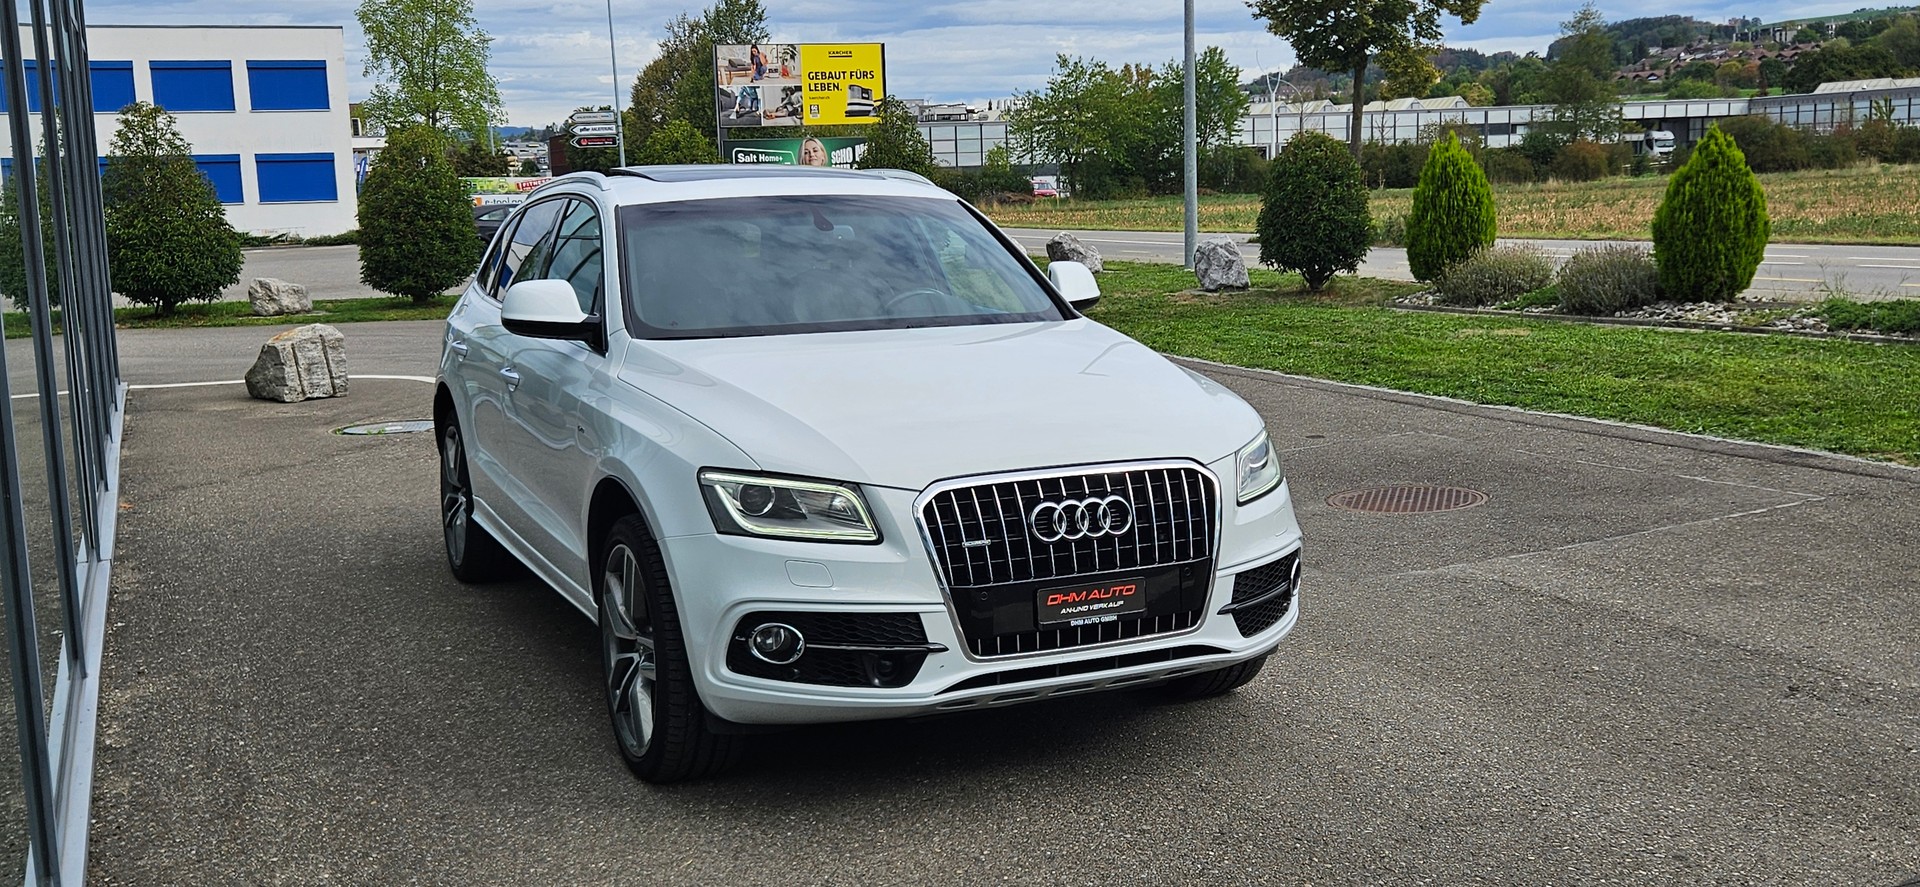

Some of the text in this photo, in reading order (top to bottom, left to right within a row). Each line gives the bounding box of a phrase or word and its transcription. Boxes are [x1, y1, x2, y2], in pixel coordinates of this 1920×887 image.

[808, 69, 875, 80] GEBAUT FÜRS
[808, 82, 842, 92] LEBEN.
[737, 152, 783, 163] Salt Home+
[831, 147, 853, 164] SCHO
[1047, 584, 1136, 606] DHM AUTO
[1089, 600, 1124, 611] VERKAUF
[1070, 618, 1084, 626] DHM
[1084, 617, 1100, 625] AUTO
